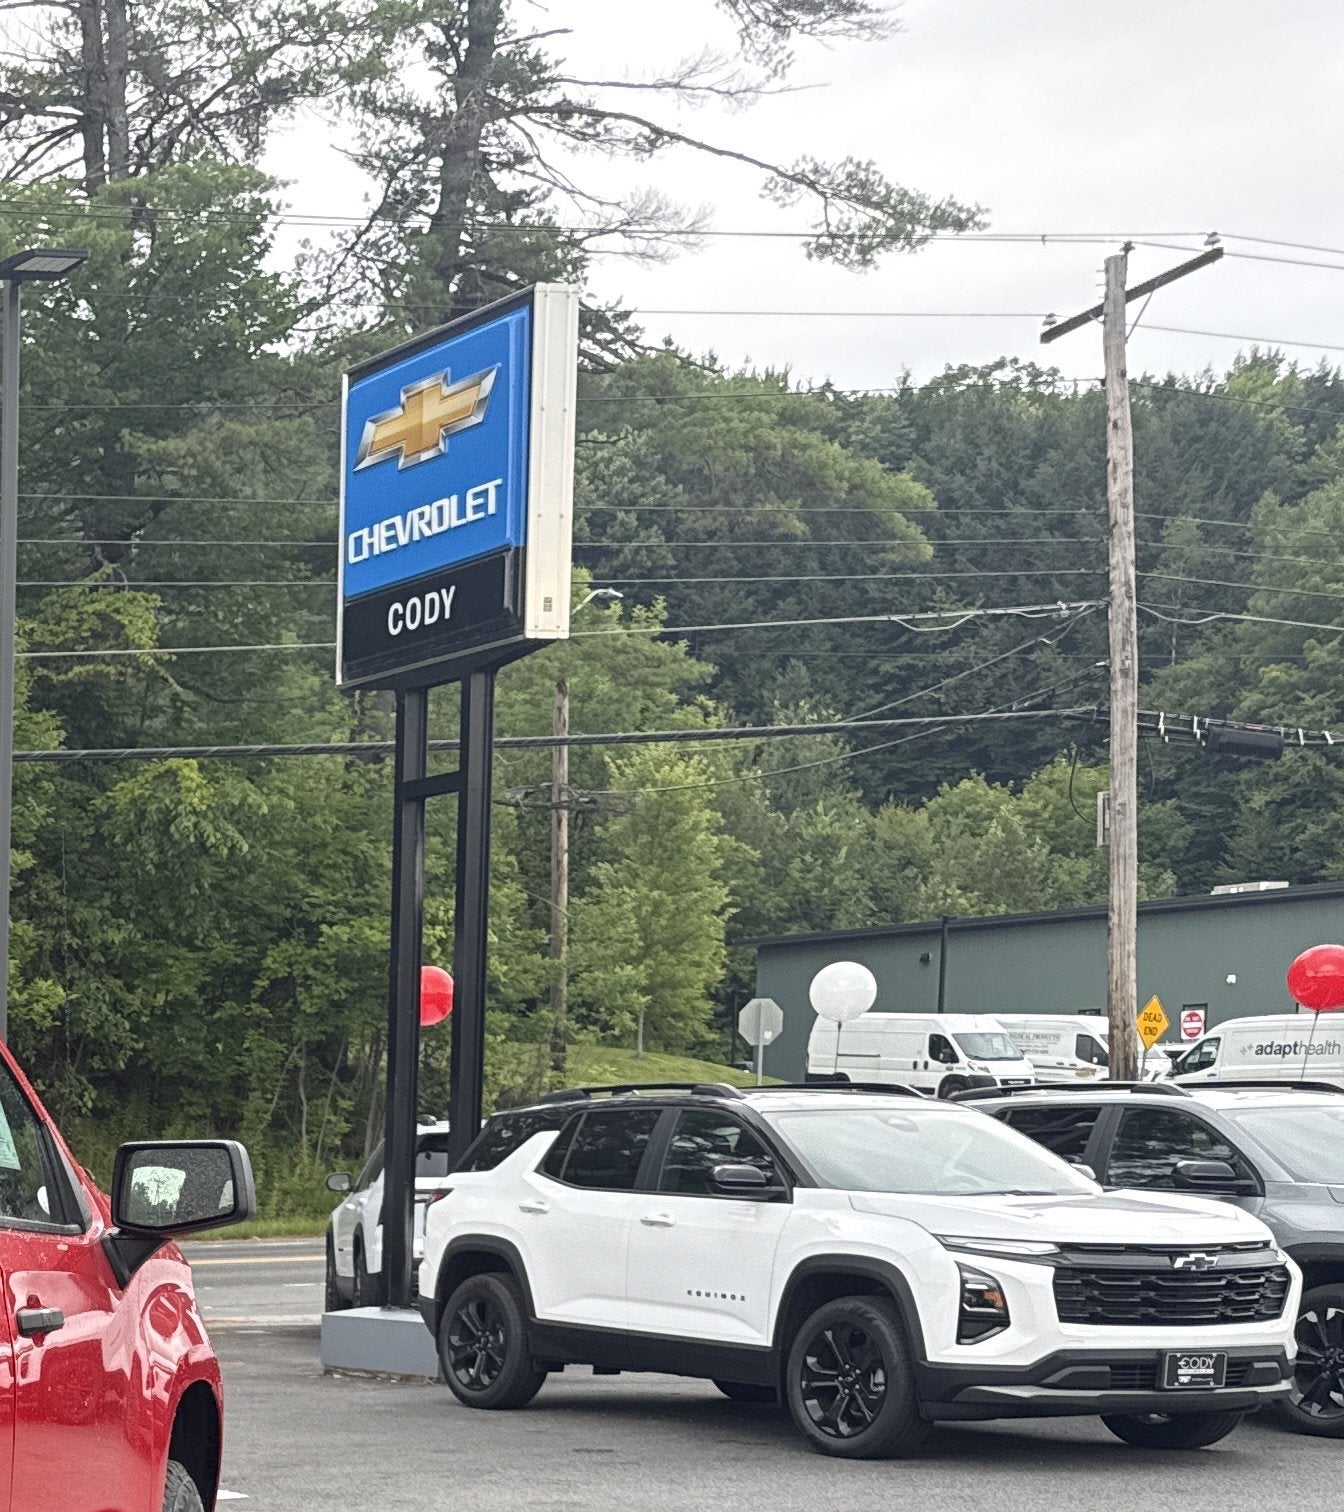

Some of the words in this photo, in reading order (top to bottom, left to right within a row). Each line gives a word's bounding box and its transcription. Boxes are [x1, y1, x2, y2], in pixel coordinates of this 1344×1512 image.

[348, 478, 503, 564] CHEVROLET
[387, 585, 456, 636] CODY
[1143, 1011, 1162, 1023] DEAD
[1144, 1026, 1158, 1036] END
[1255, 1040, 1341, 1058] adapthealth
[1180, 1357, 1215, 1369] CODY
